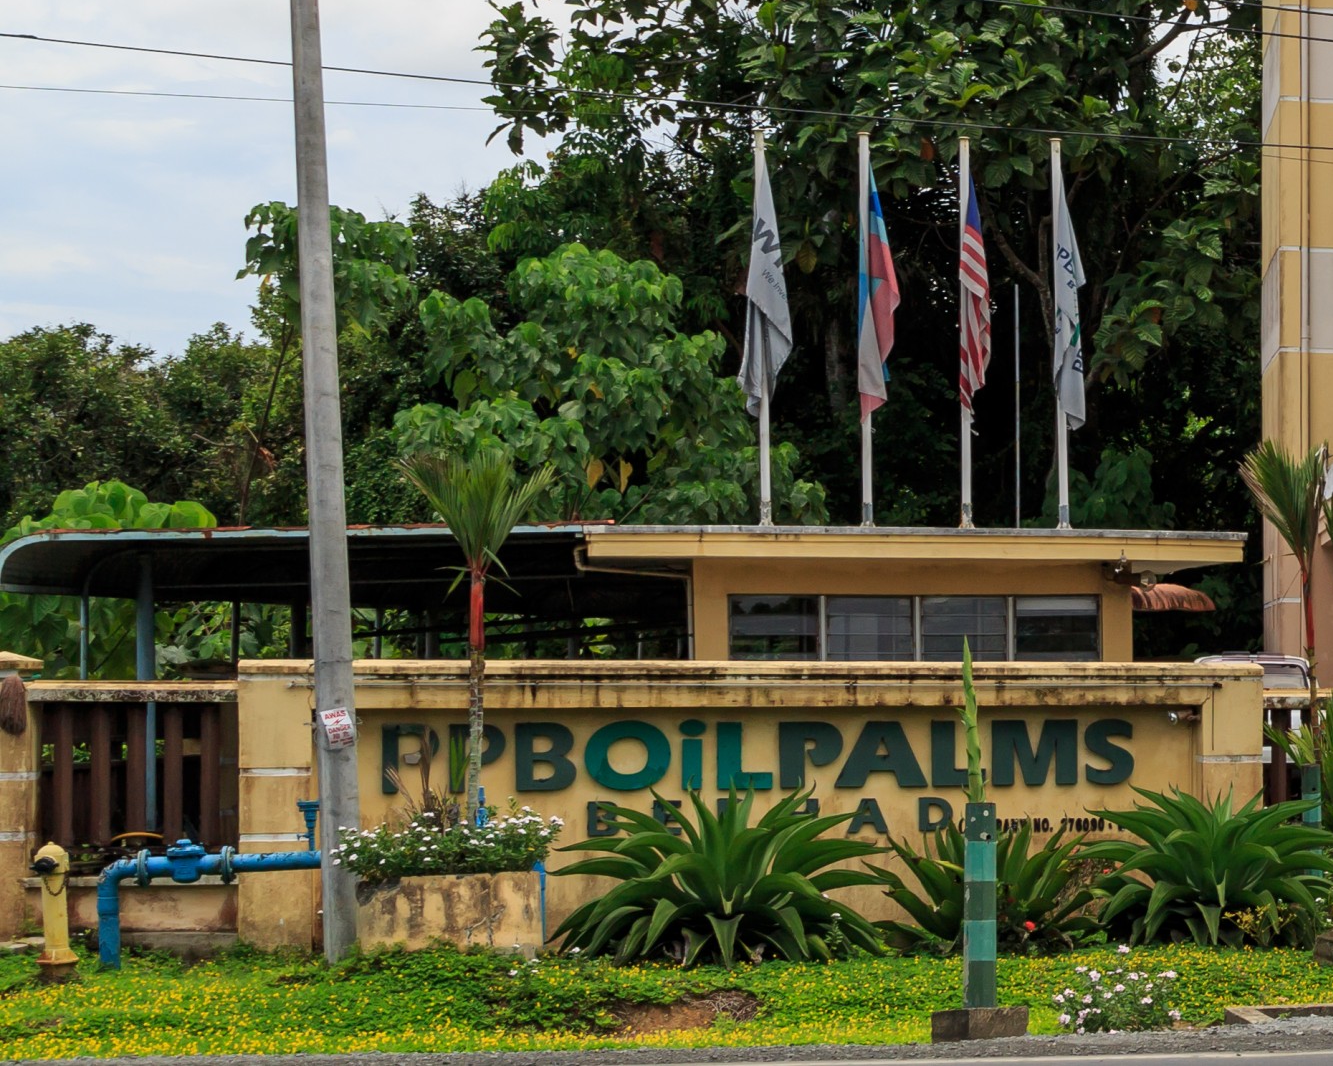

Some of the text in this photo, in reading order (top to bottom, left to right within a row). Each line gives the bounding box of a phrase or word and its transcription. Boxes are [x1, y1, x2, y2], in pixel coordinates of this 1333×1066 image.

[324, 710, 346, 719] AWAS
[328, 724, 352, 734] DANGER
[1033, 817, 1054, 833] NO.
